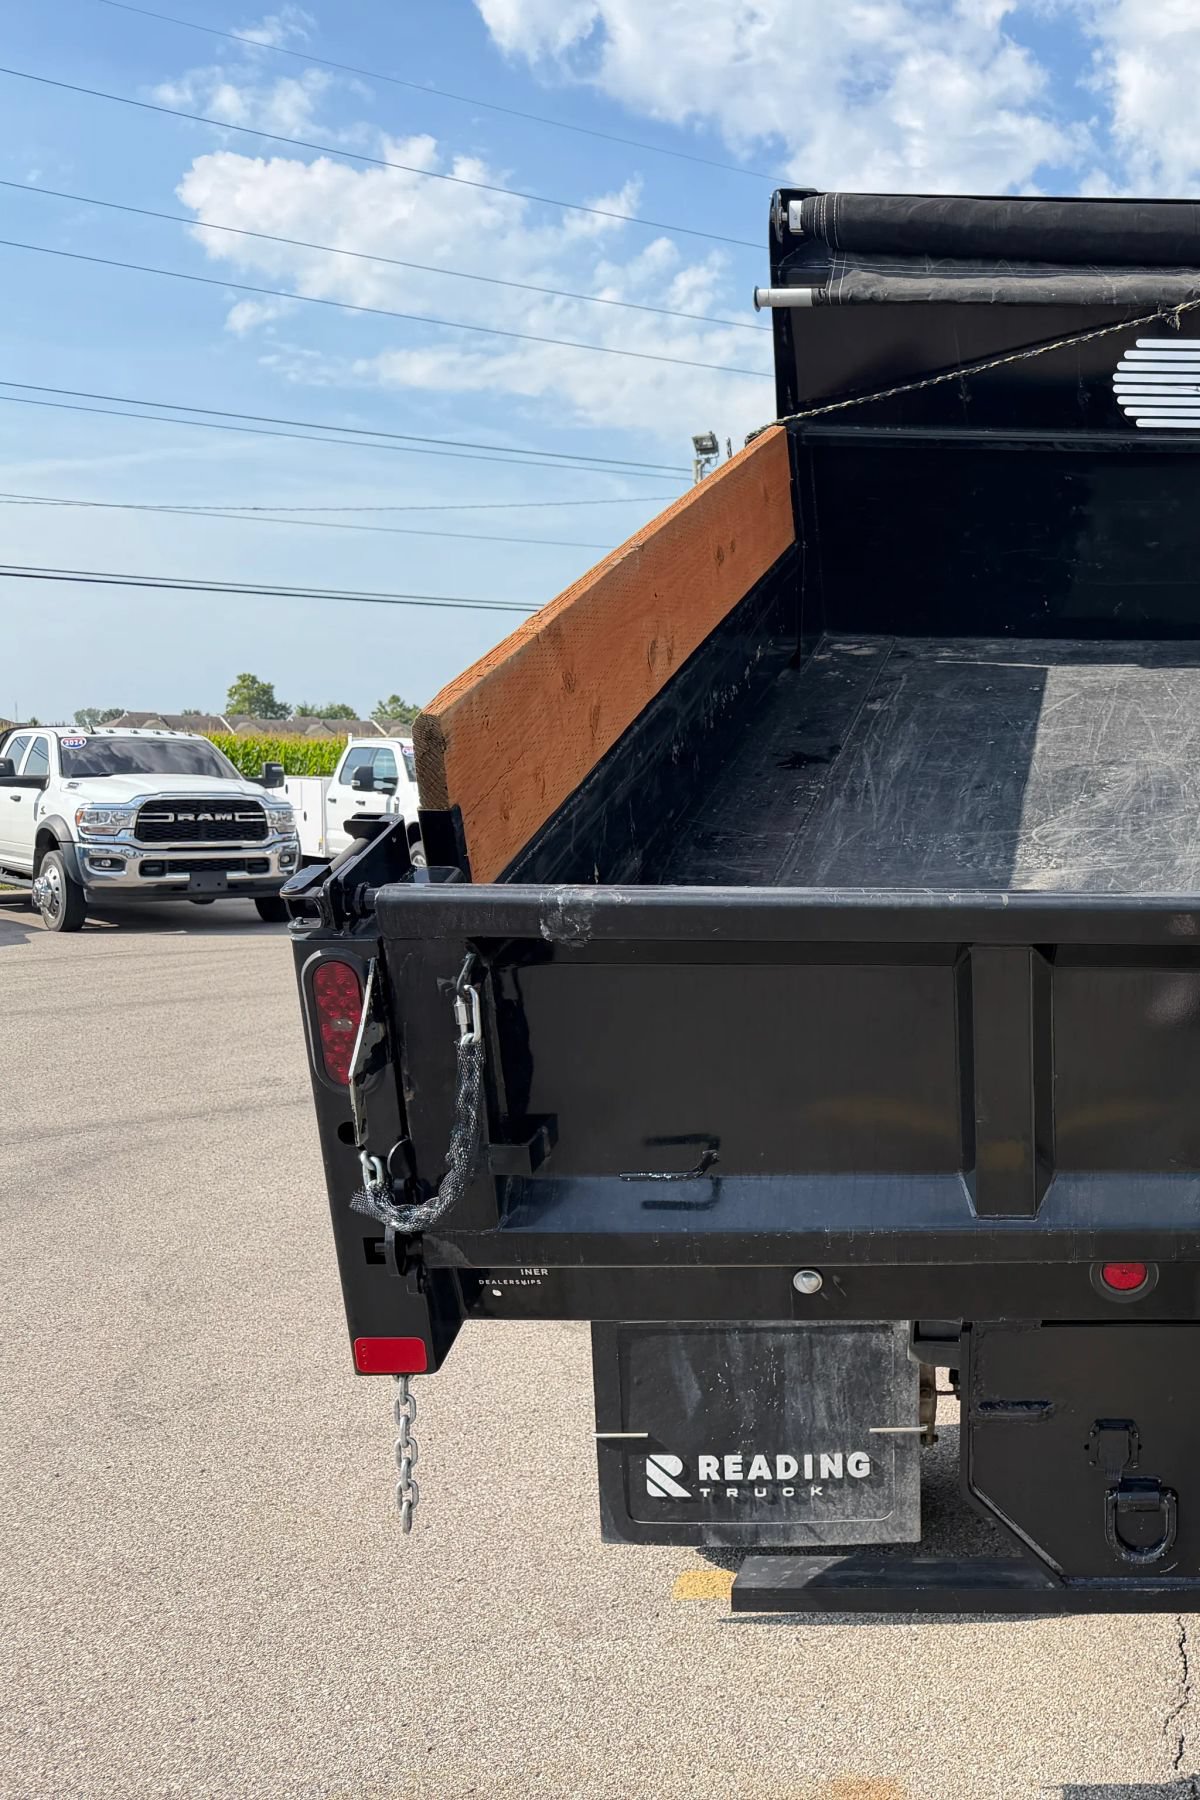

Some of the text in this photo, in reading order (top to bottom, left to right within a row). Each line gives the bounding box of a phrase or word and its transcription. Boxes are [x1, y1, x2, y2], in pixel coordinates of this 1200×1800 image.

[177, 813, 233, 821] RAM
[698, 1451, 871, 1480] READING
[699, 1487, 823, 1497] TRUCK
